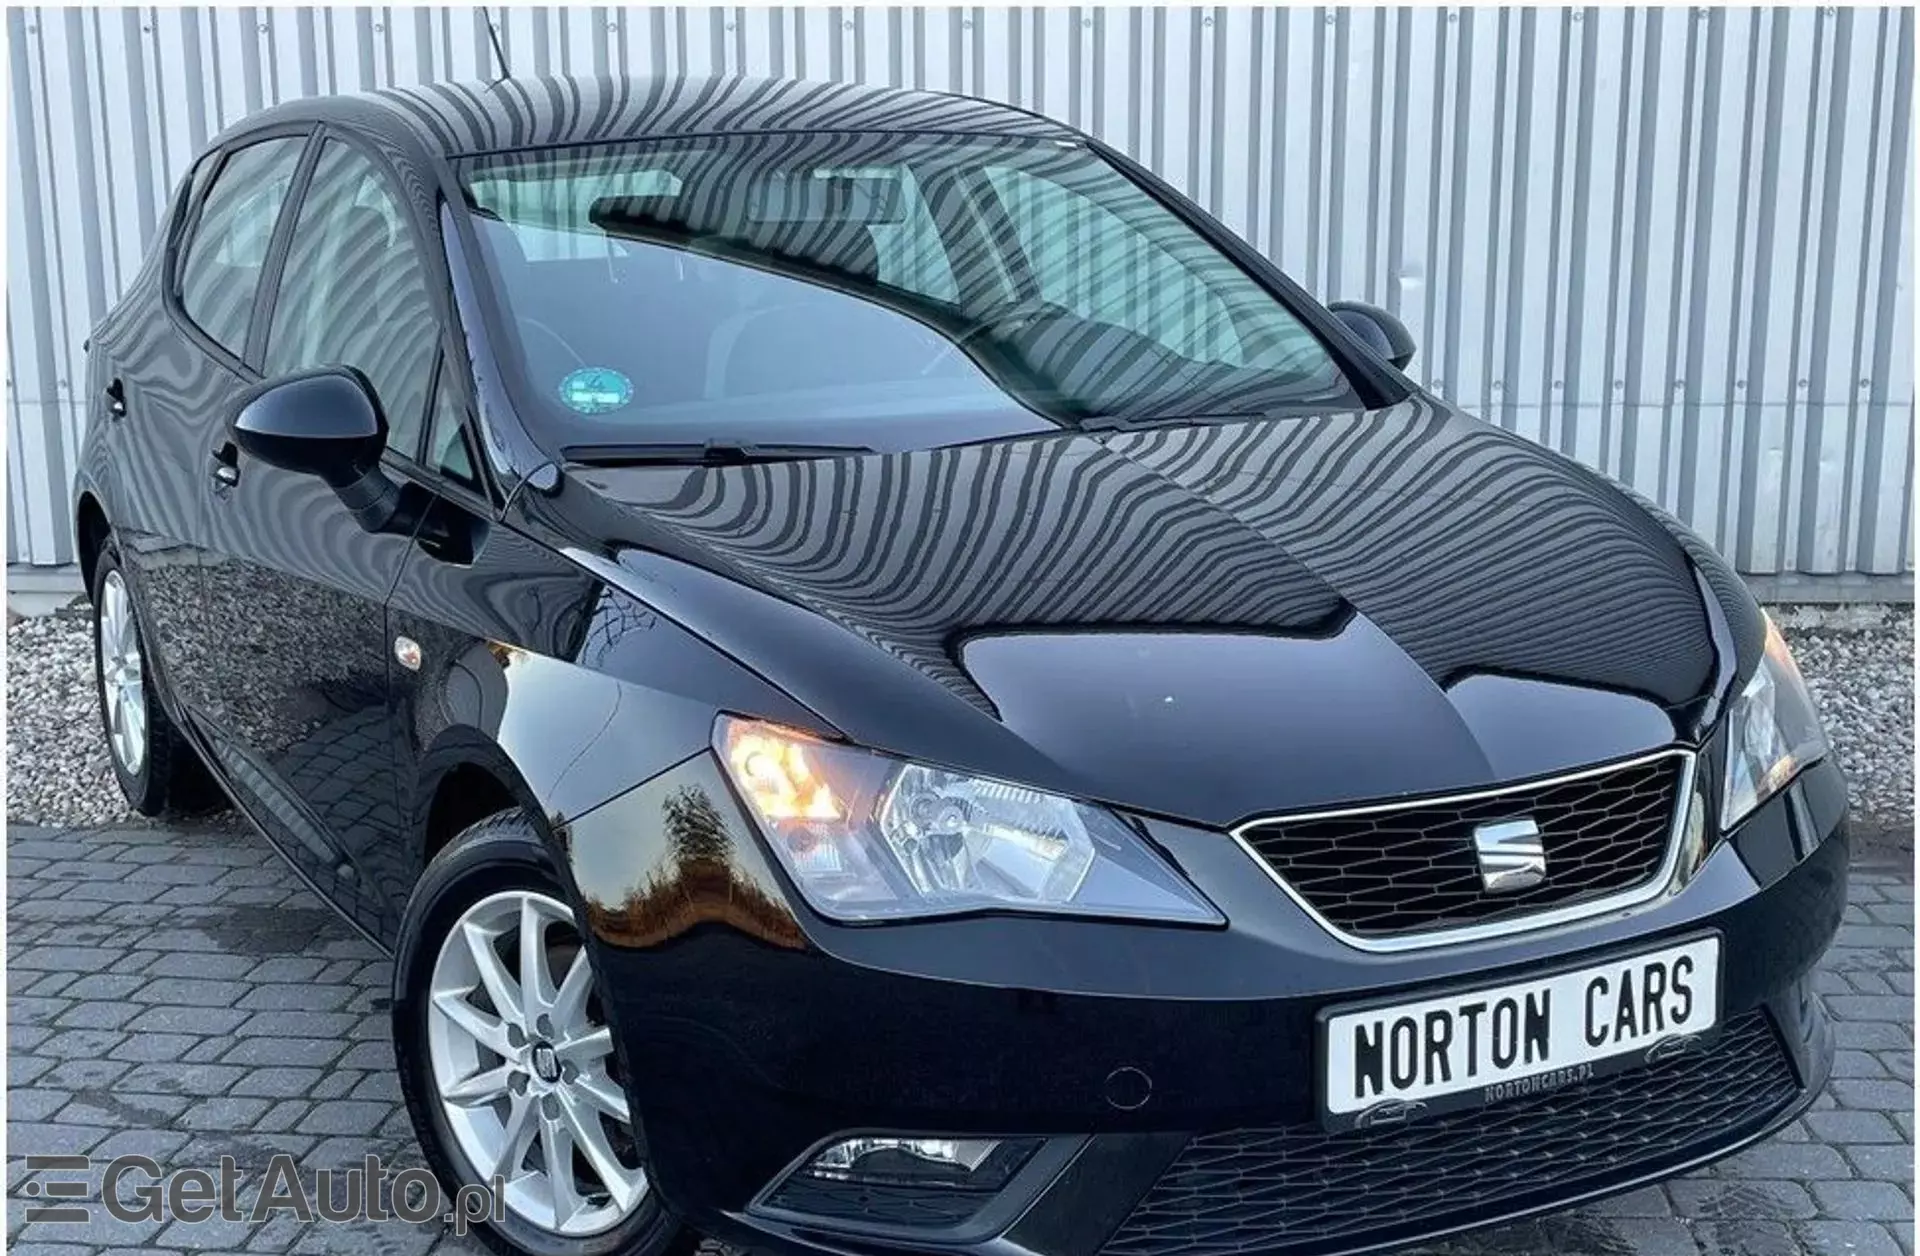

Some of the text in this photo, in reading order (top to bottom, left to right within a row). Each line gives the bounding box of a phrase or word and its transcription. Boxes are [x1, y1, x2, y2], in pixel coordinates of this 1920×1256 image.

[1354, 955, 1694, 1099] NORTON CARS
[1484, 1063, 1595, 1103] NORTONCARS.PL
